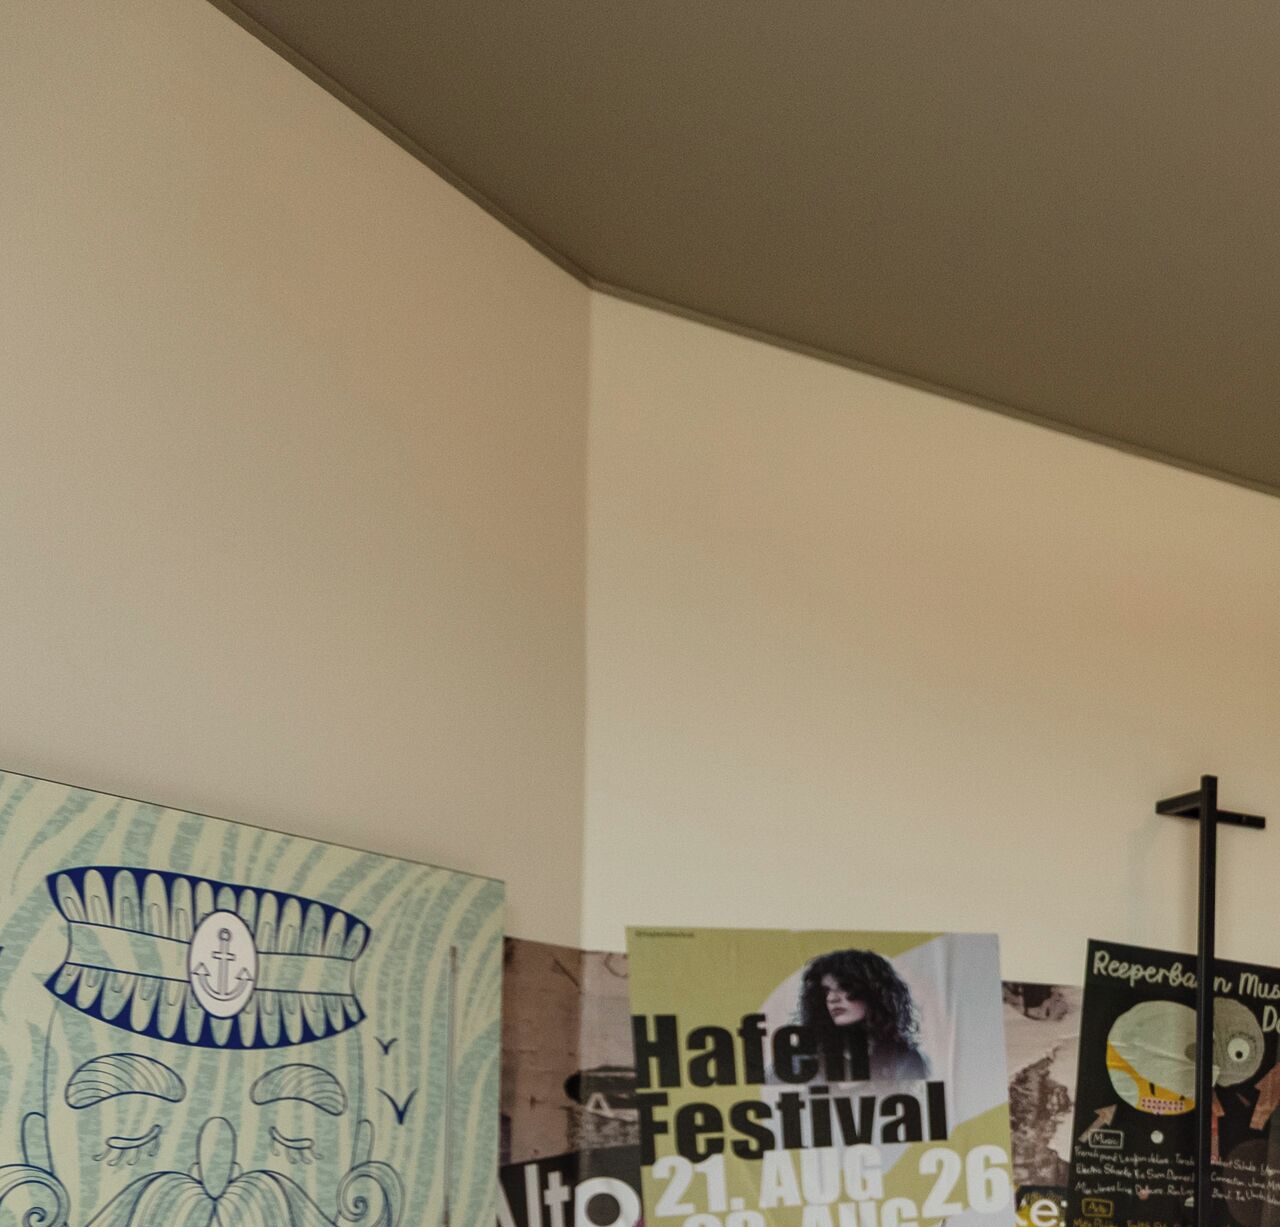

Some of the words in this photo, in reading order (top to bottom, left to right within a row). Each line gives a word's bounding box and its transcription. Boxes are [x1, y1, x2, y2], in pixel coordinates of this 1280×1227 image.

[1093, 950, 1232, 993] Reeperban
[631, 1013, 871, 1089] Hafen
[638, 1081, 948, 1168] Festival
[653, 1152, 745, 1217] 21.
[758, 1143, 886, 1209] AUG
[918, 1144, 1013, 1219] 26
